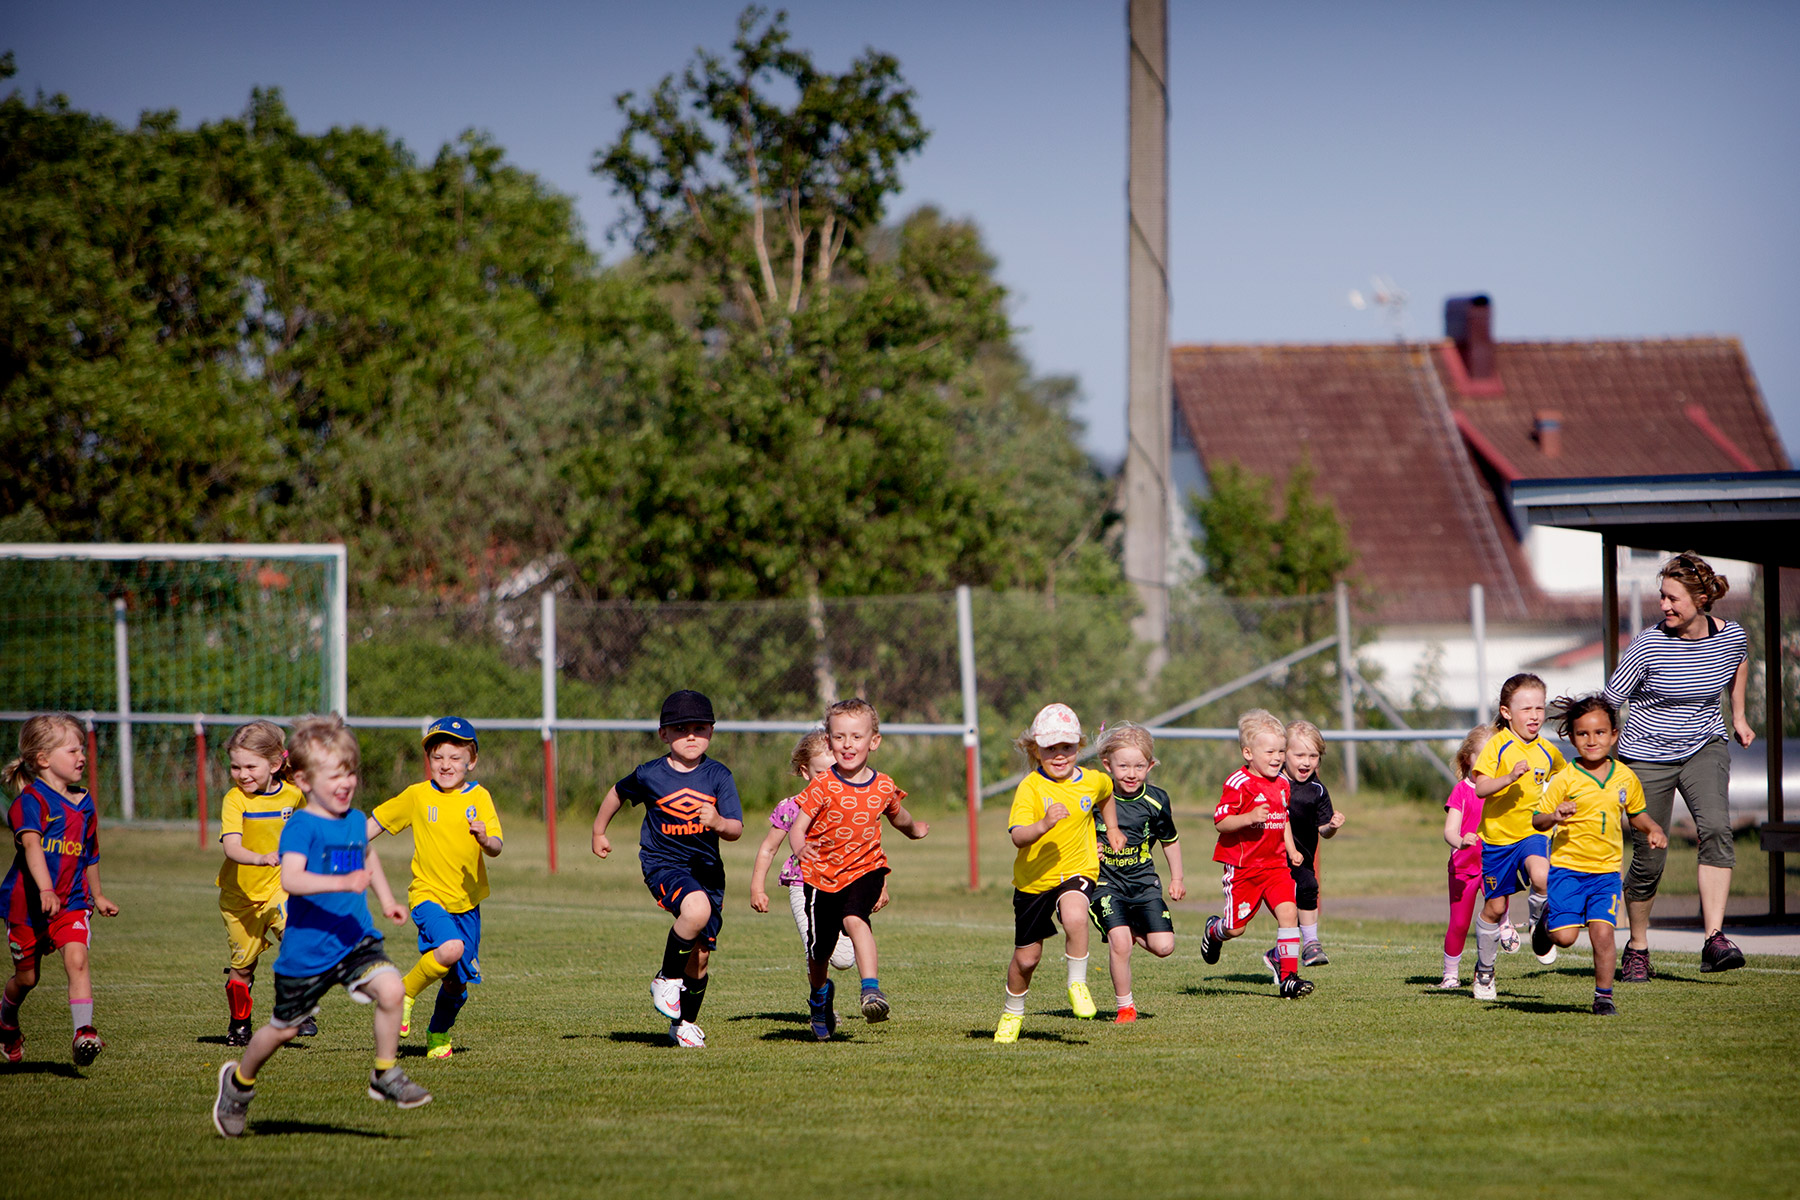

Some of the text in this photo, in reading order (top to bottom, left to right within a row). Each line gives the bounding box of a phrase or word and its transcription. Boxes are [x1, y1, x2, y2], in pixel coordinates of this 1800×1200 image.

[427, 806, 438, 822] 10
[661, 820, 711, 835] umbr
[40, 836, 83, 856] unice
